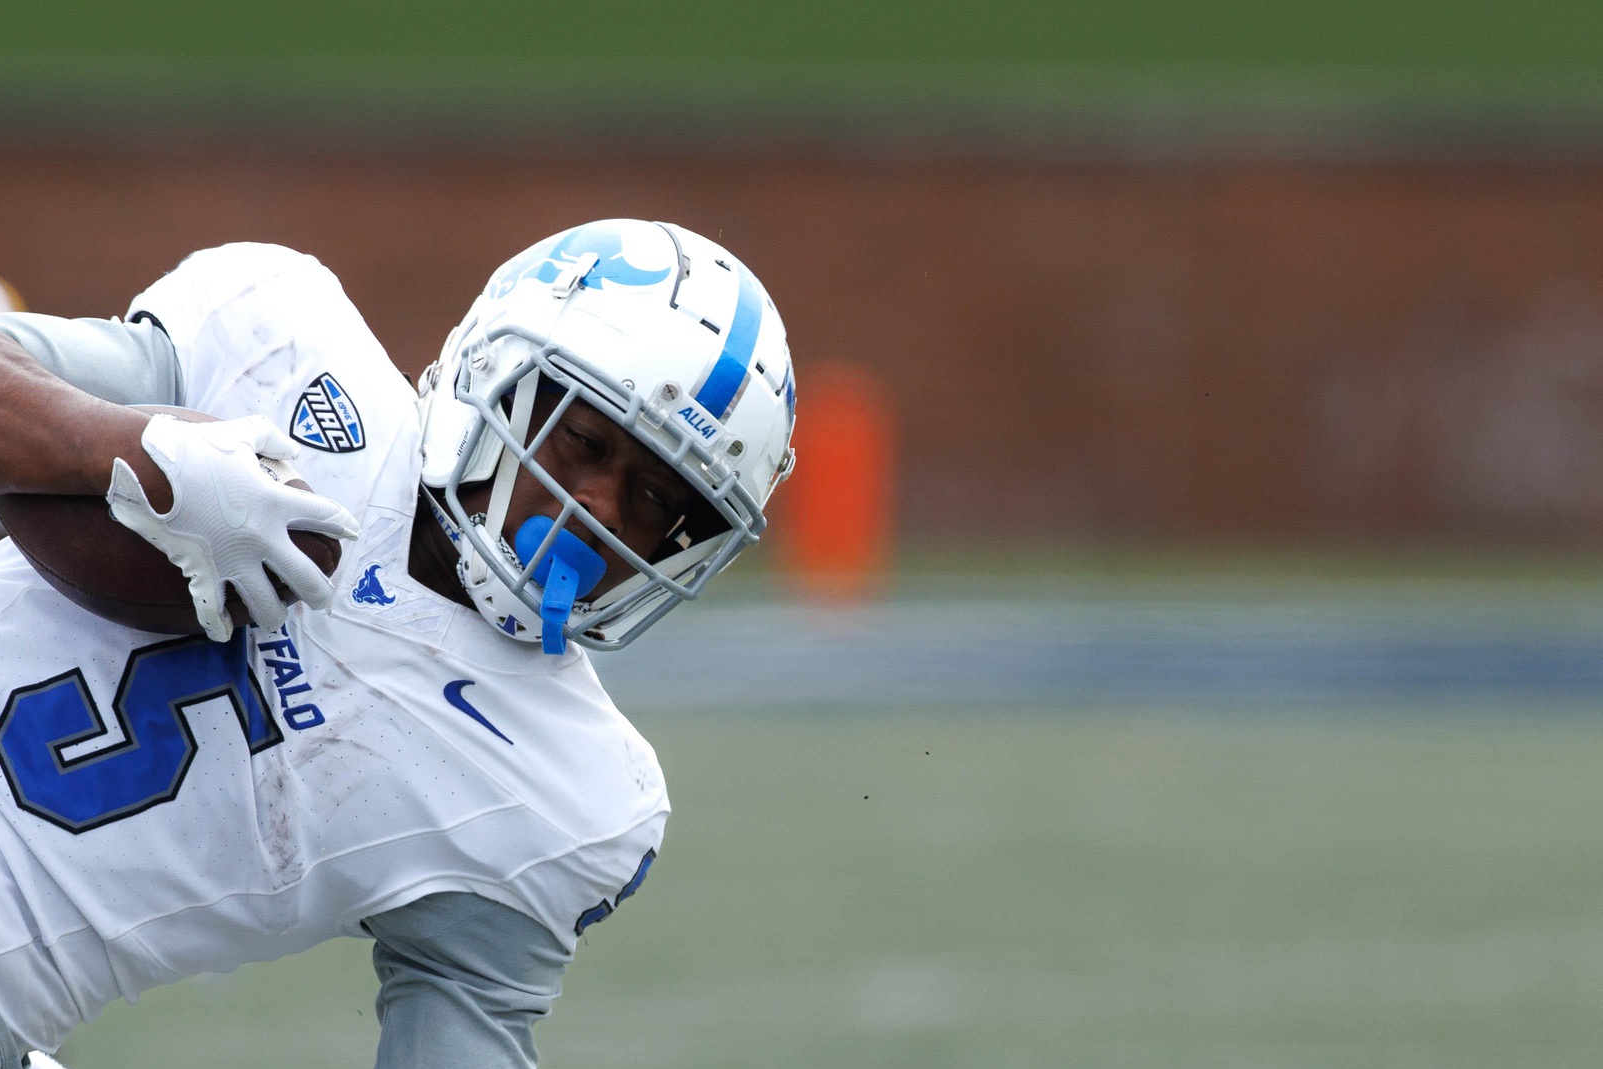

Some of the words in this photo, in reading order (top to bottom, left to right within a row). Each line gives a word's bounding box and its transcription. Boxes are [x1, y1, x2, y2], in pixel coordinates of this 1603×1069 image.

[305, 384, 352, 452] MAC
[337, 401, 353, 420] 1946
[677, 406, 717, 440] ALL41
[432, 506, 452, 532] ORT
